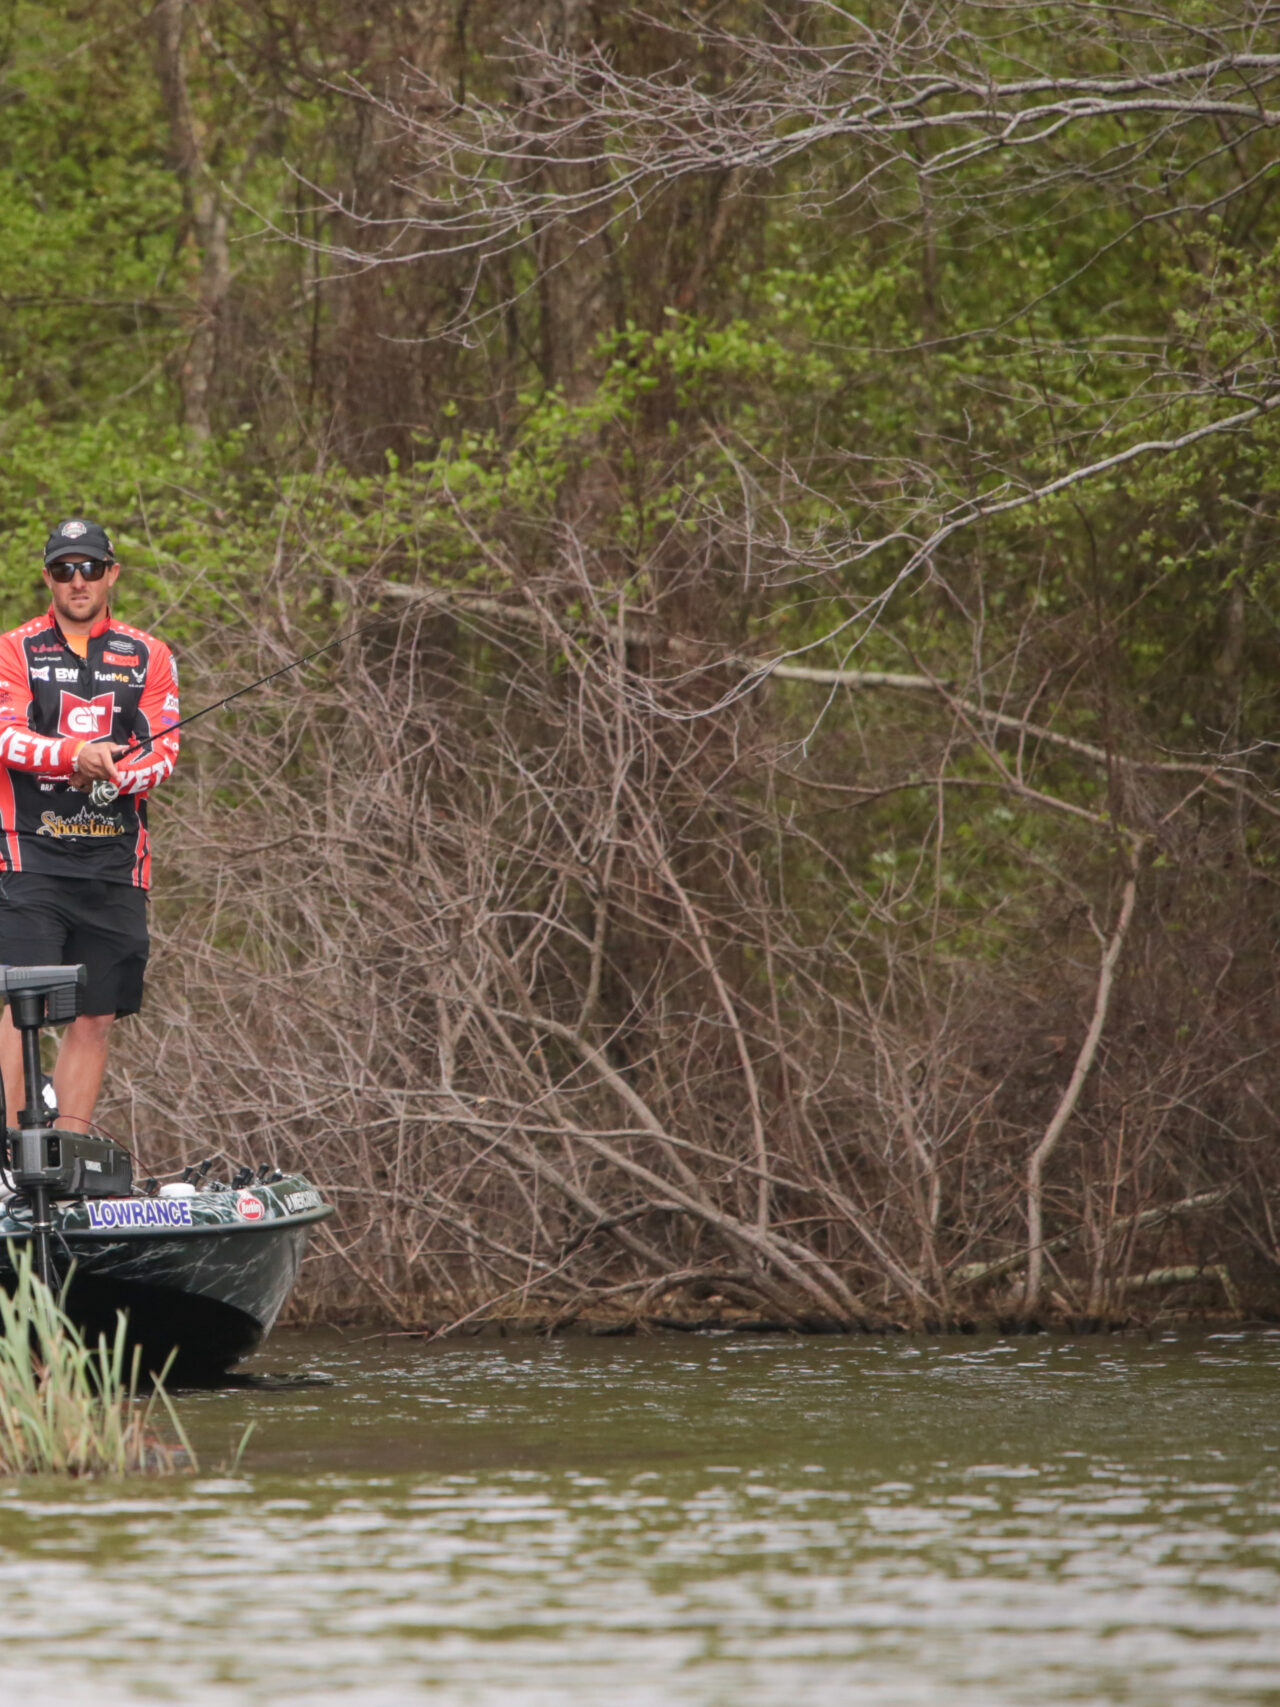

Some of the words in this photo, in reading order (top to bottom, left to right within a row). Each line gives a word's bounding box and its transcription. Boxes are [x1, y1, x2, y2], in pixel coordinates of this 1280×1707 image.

[55, 667, 79, 680] BW
[94, 670, 130, 683] FuelMe
[67, 705, 106, 733] GT
[88, 1201, 192, 1228] LOWRANCE
